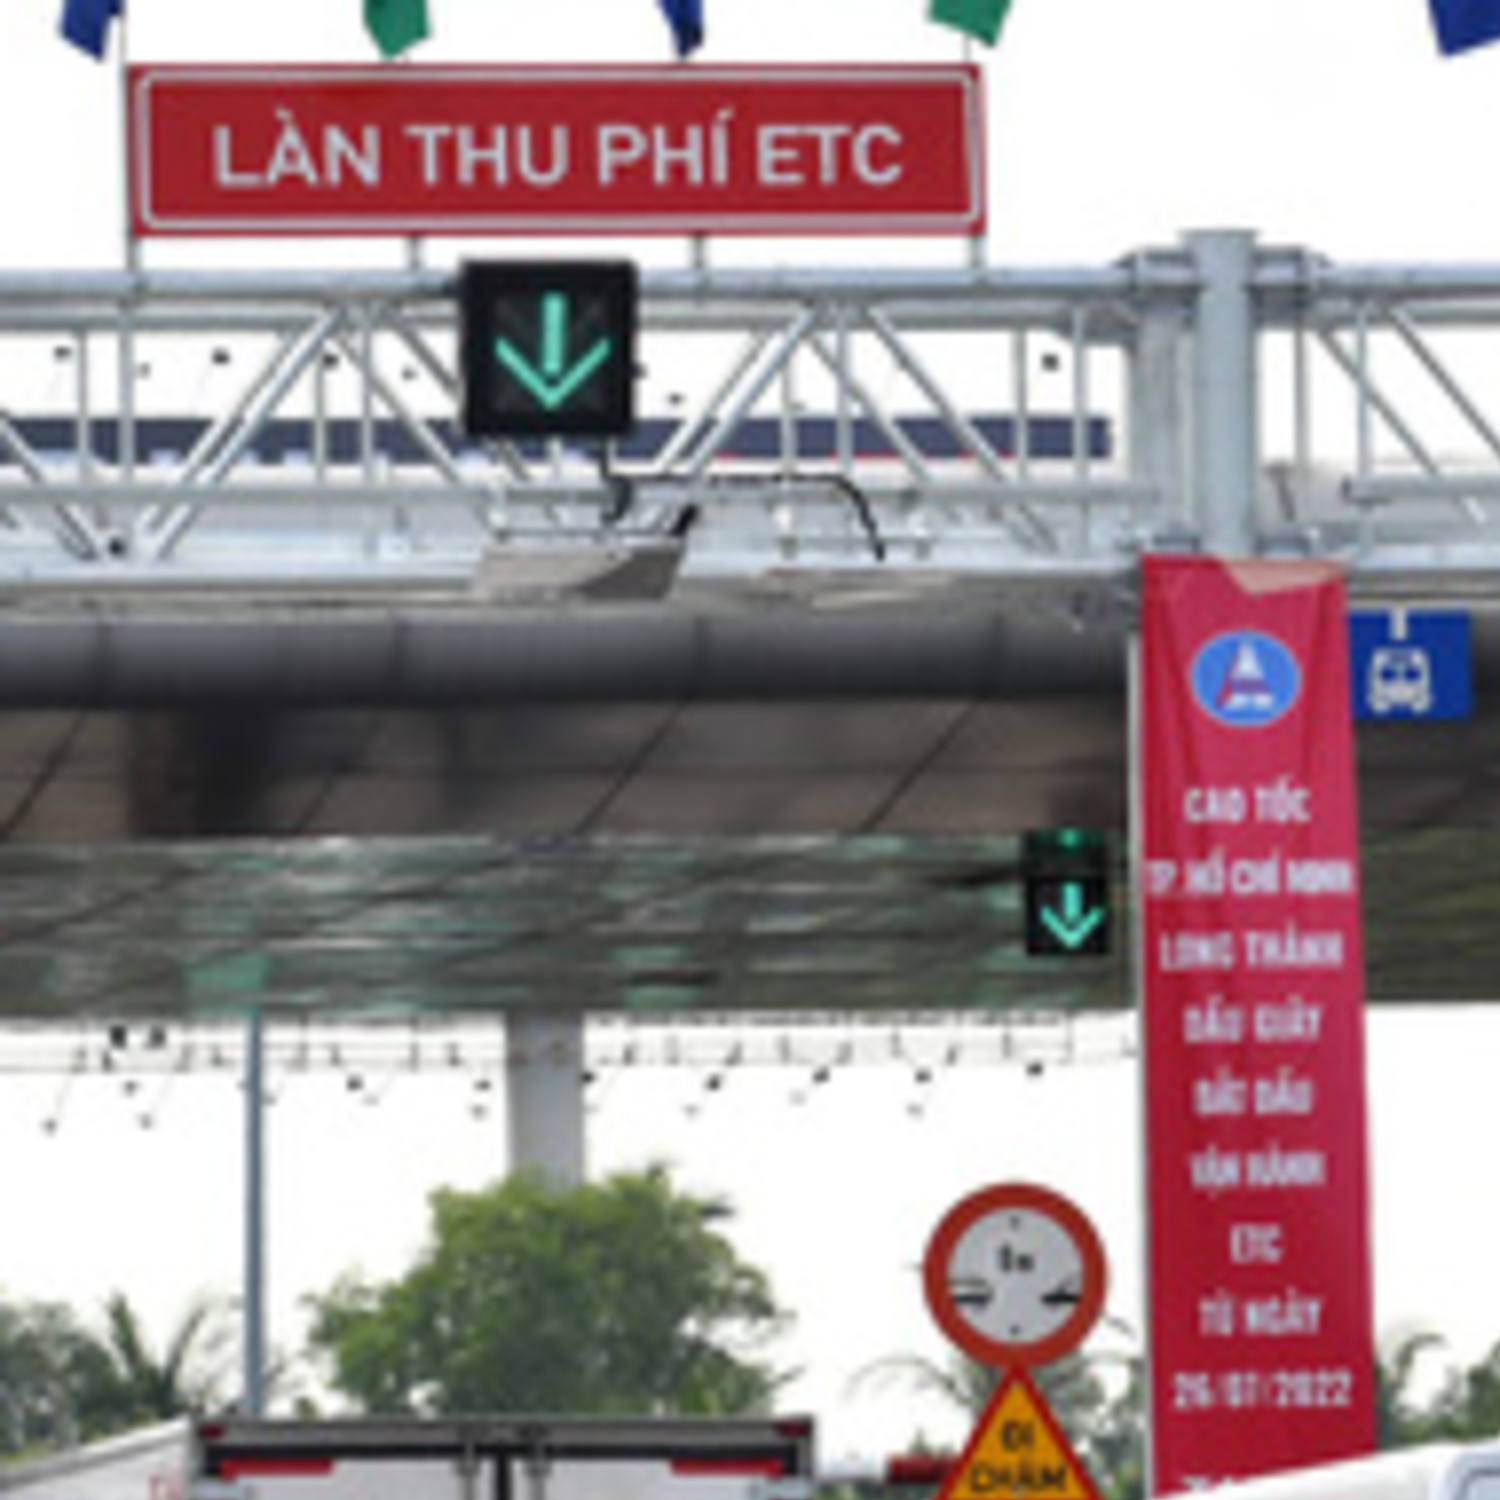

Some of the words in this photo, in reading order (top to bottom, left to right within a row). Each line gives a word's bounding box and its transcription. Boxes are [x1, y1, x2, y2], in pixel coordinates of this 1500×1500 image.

[213, 109, 380, 188] LÀN
[405, 124, 567, 186] THU
[599, 109, 732, 186] PHÍ
[756, 125, 902, 184] ETC
[1184, 786, 1246, 823] CAO
[1160, 930, 1235, 972] LONG
